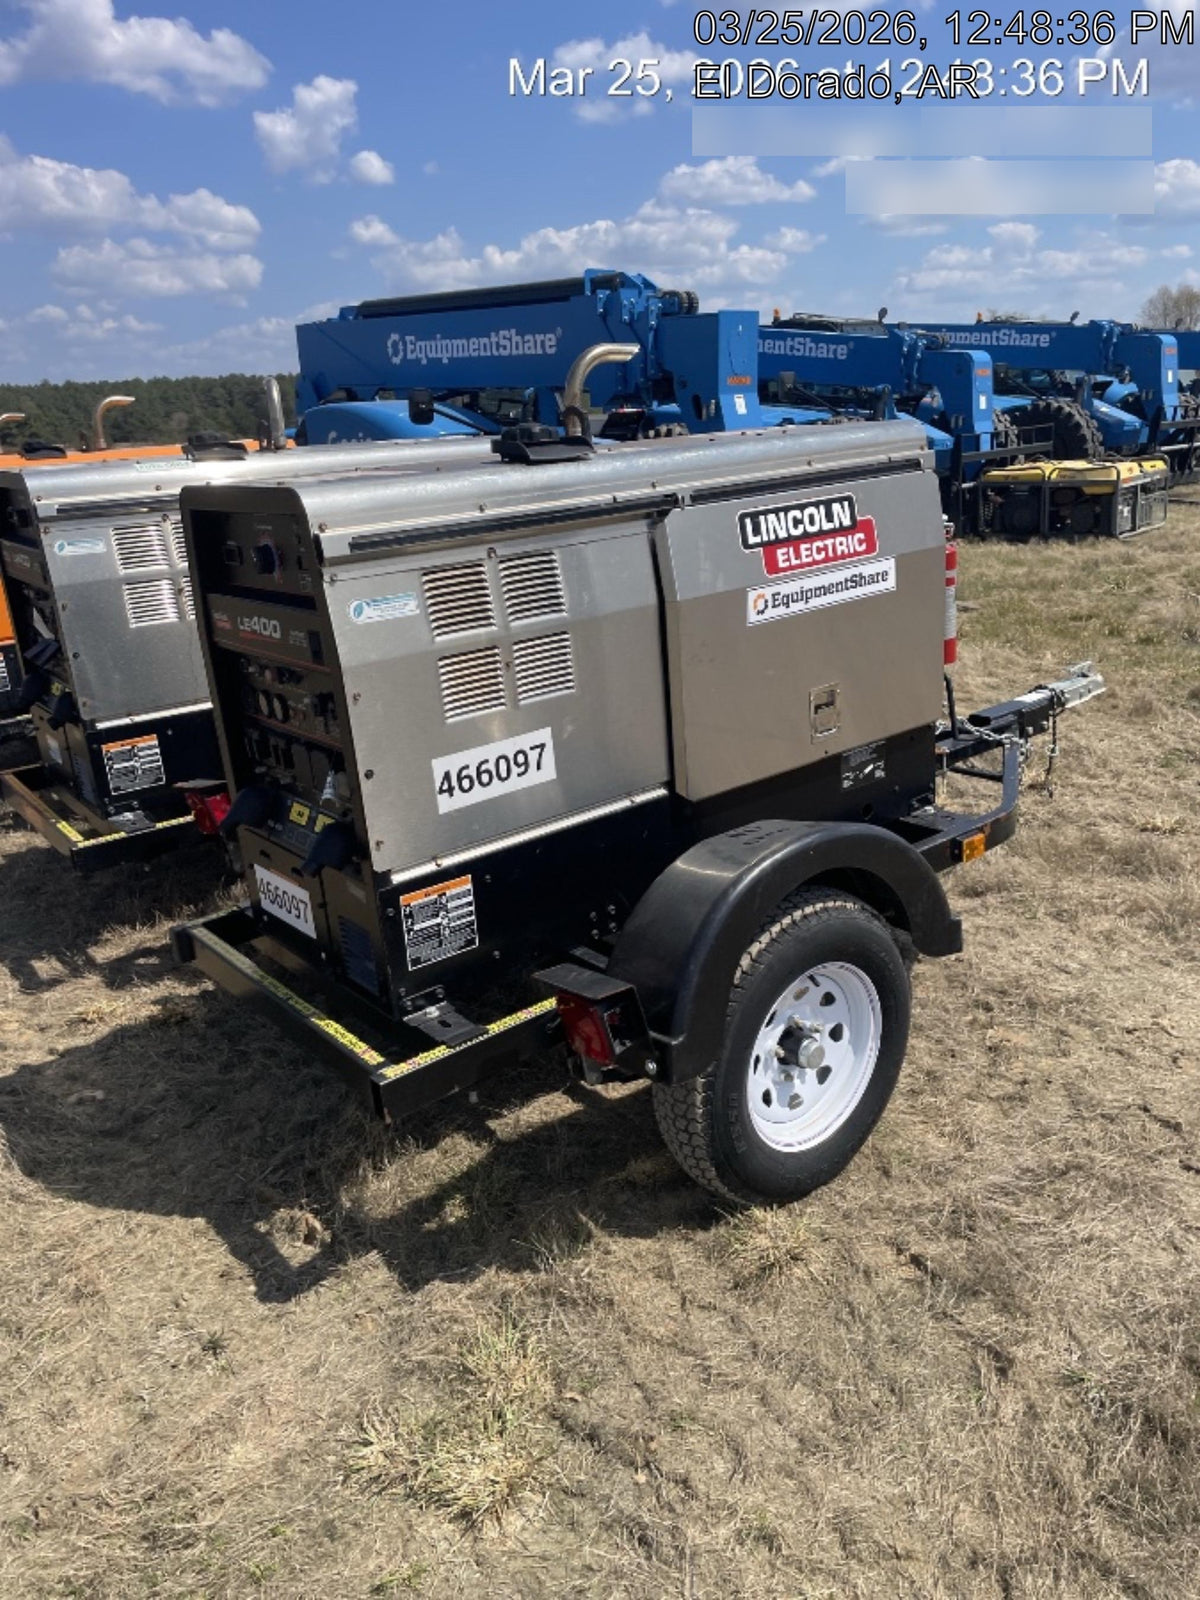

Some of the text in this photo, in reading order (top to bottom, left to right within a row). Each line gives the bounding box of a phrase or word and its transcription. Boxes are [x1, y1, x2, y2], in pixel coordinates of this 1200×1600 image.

[744, 501, 852, 545] LINCOLN
[776, 533, 867, 568] ELECTRIC
[771, 569, 889, 609] EquipmentShare
[237, 616, 281, 639] LE400
[439, 743, 546, 798] 466097
[259, 877, 308, 925] 466097
